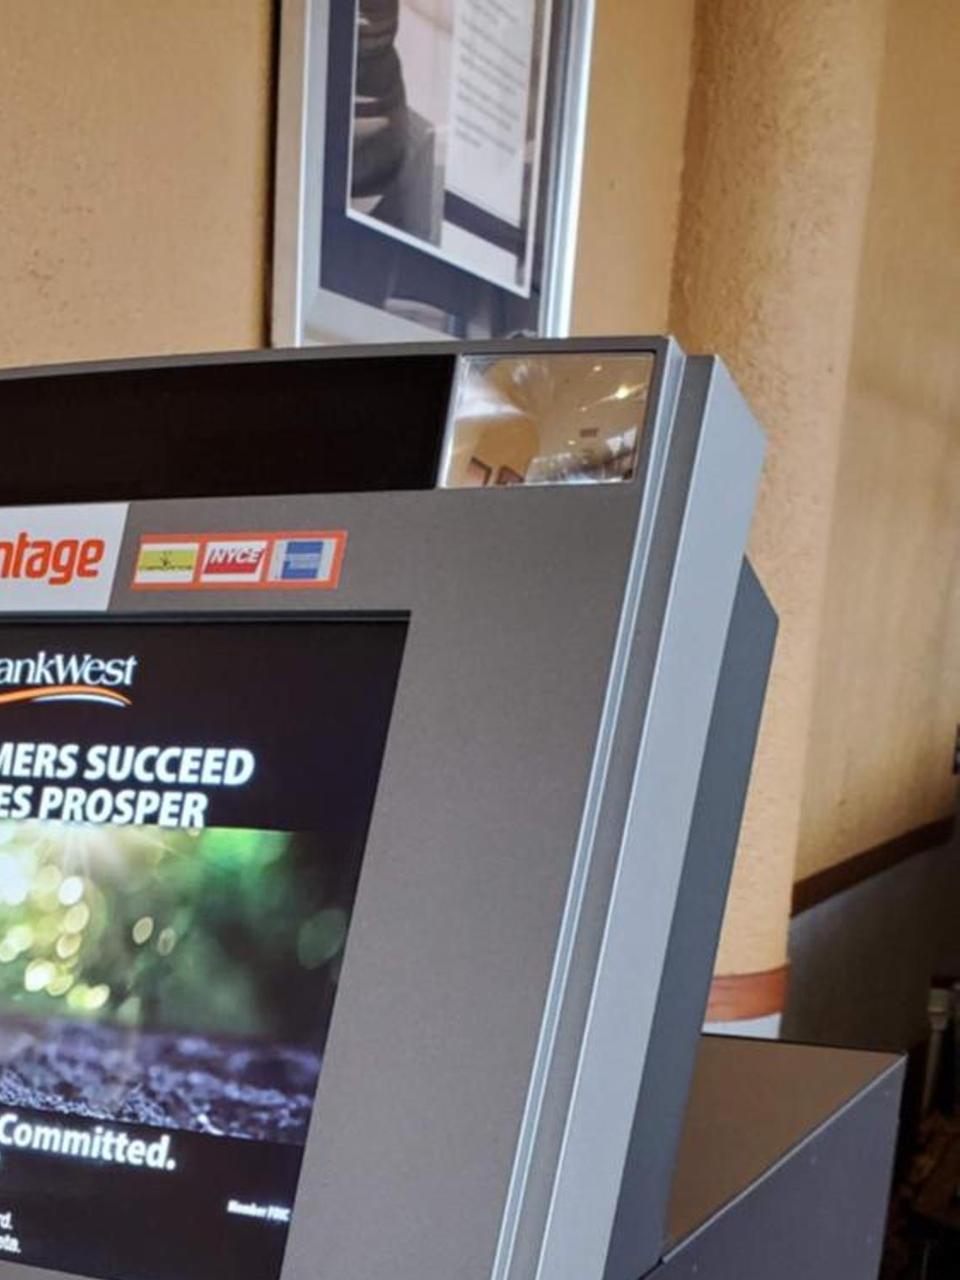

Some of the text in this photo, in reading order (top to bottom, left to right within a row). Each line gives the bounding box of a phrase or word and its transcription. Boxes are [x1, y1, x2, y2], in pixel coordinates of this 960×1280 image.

[209, 548, 262, 564] NYCE
[83, 744, 256, 786] SUCCEED
[38, 786, 209, 829] PROSPER
